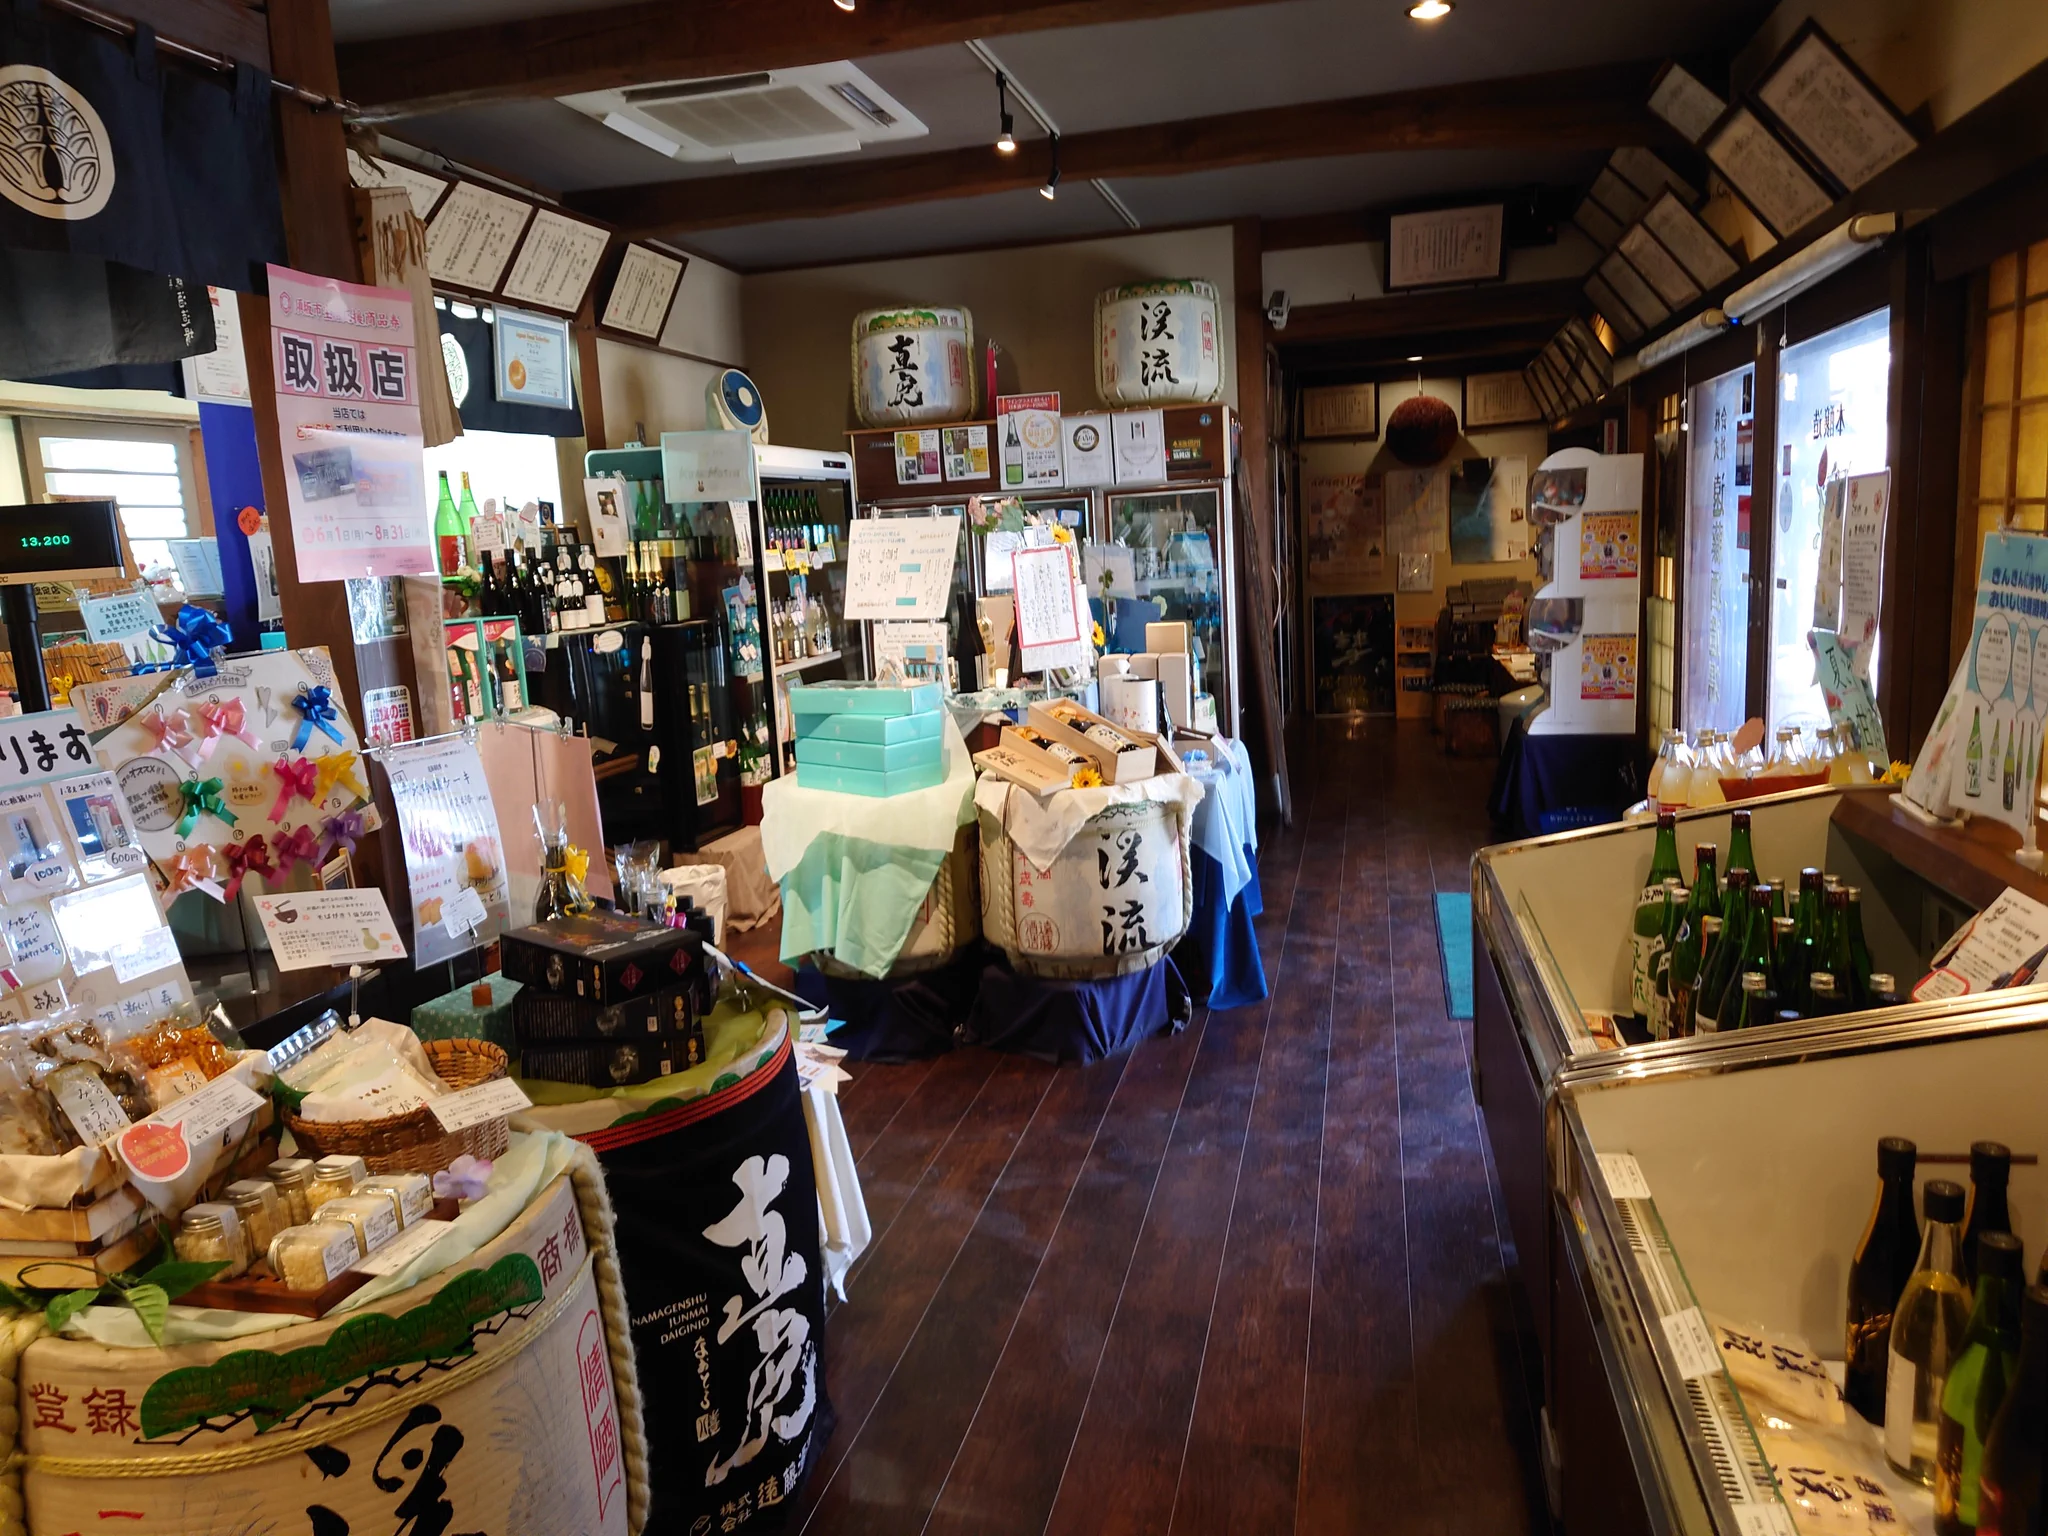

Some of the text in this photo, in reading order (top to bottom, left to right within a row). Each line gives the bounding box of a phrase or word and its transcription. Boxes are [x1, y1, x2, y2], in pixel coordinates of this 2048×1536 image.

[1140, 300, 1180, 386] 渓流
[282, 335, 405, 399] 取扱店
[887, 334, 924, 407] 直虎
[332, 407, 366, 421] 当店では
[34, 865, 63, 882] 100円
[111, 851, 140, 864] 600円
[1096, 828, 1157, 955] 渓流
[7, 910, 38, 931] メッセージ
[537, 1205, 580, 1288] 商標
[631, 1292, 708, 1328] NAMAGENSHU
[668, 1304, 709, 1329] JUNMAI
[660, 1316, 710, 1345] DAIGINJO
[28, 1383, 140, 1438] 登録
[583, 1339, 616, 1481] 清酒
[720, 1491, 752, 1516] 株式
[720, 1507, 752, 1533] 会社
